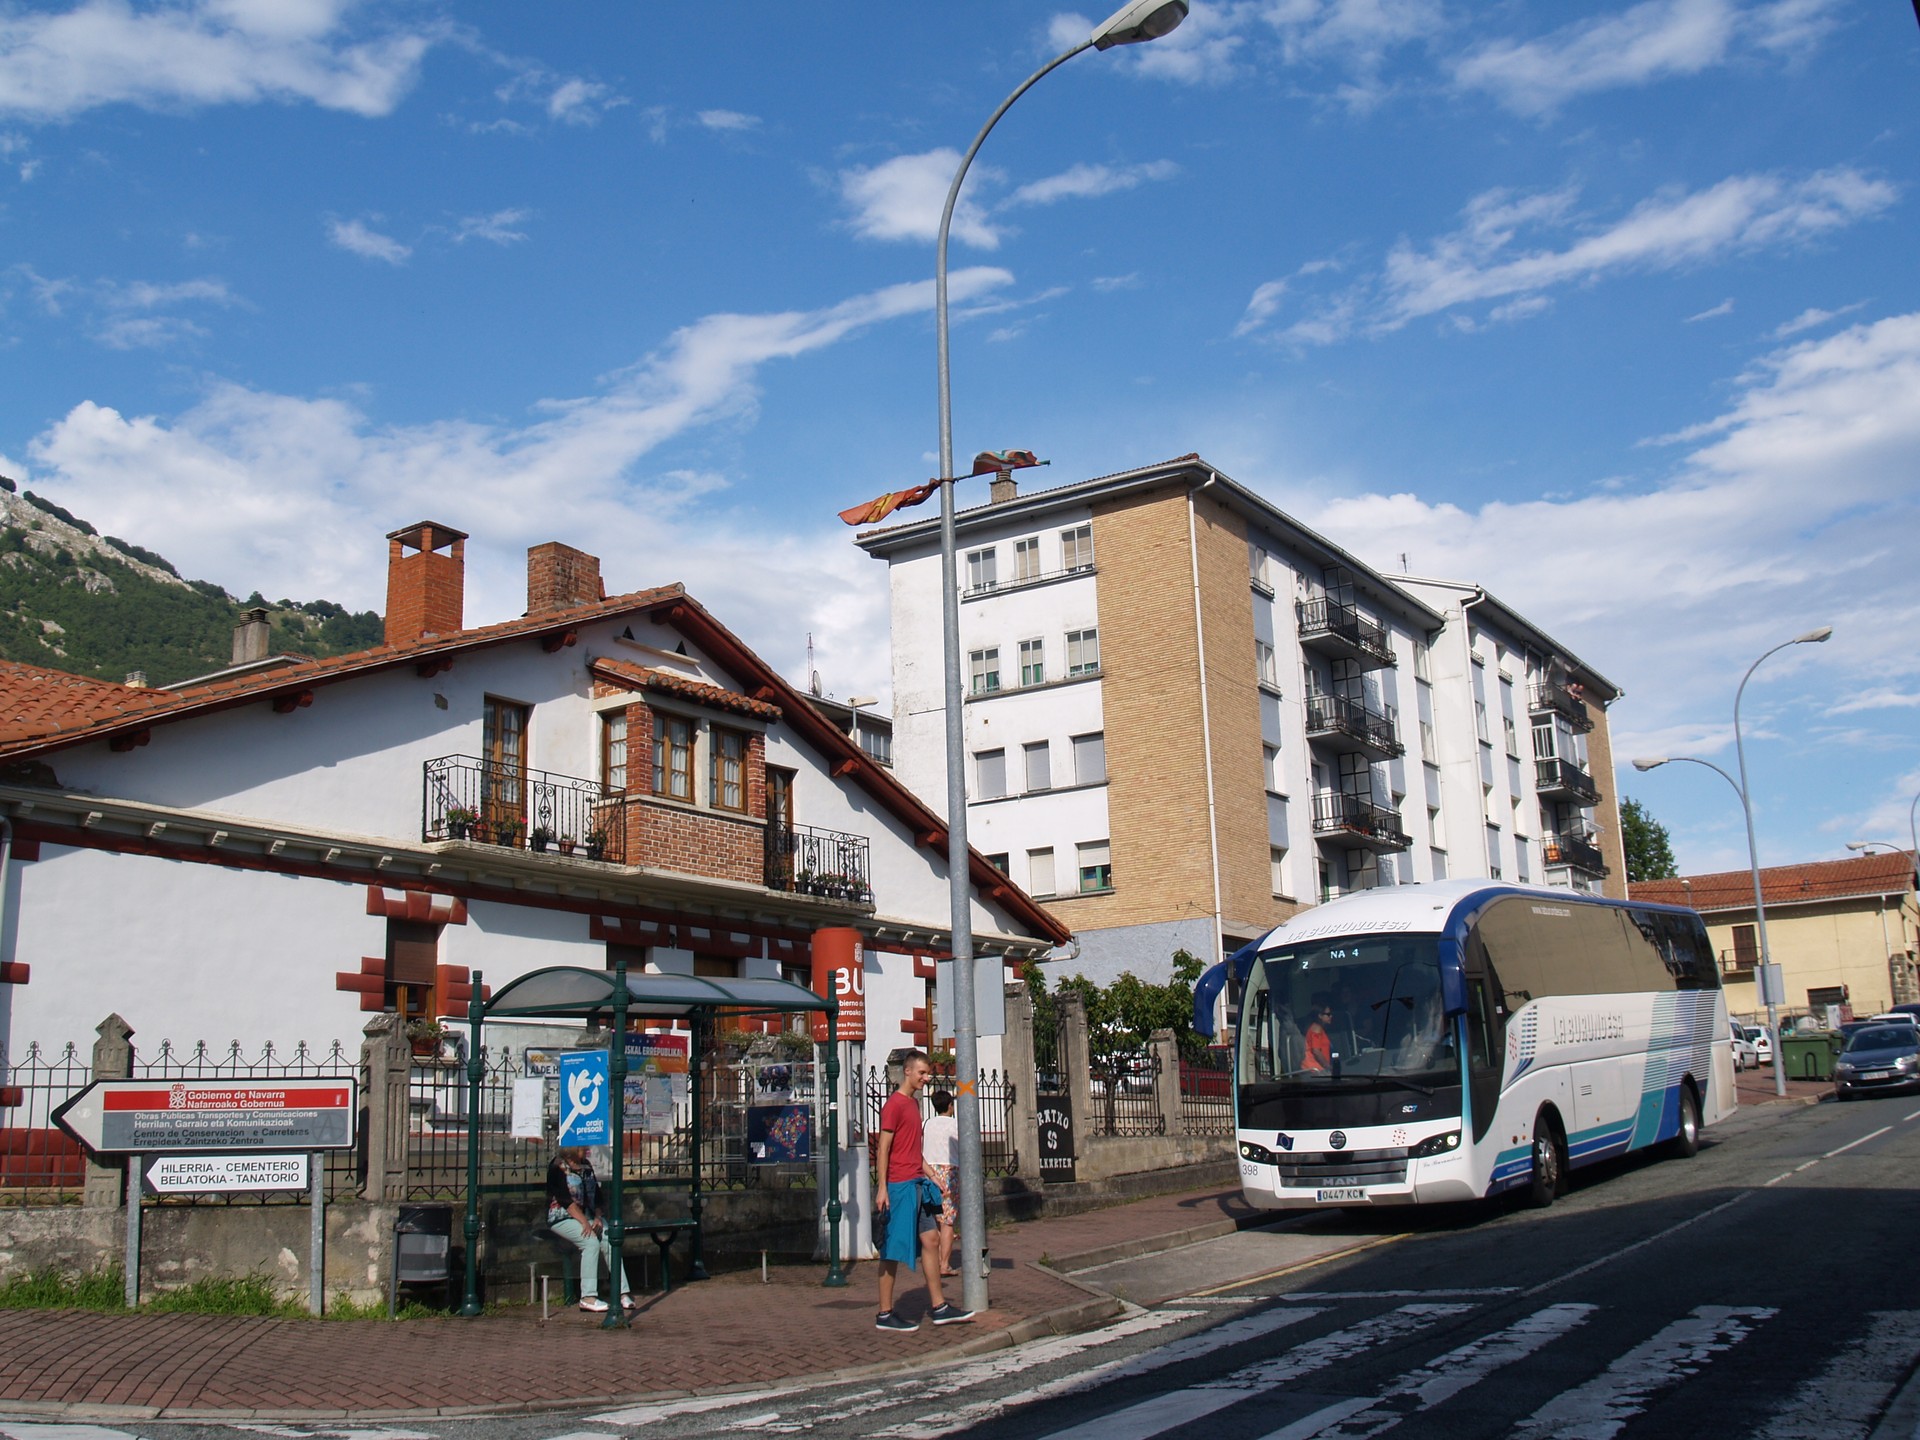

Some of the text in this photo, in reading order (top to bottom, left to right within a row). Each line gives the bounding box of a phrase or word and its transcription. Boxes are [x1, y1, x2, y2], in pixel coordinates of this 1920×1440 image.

[1285, 929, 1307, 944] LA
[1330, 948, 1359, 959] NA 4
[530, 1065, 551, 1075] ALDE
[187, 1090, 286, 1100] Gobierno de Navarra
[186, 1099, 285, 1109] Nafarroako Gobernua
[134, 1110, 318, 1120] Obras Públicas Transportes y Comunicaciones
[134, 1118, 294, 1129] Herrilan, Garraio eta Komunikazioak
[585, 1118, 604, 1127] orain
[133, 1129, 165, 1138] Centro
[167, 1129, 179, 1138] de
[576, 1126, 604, 1135] presoak
[133, 1136, 264, 1147] Errepideak Zaintzeko Zentroa
[161, 1163, 214, 1174] HILERRIA
[225, 1161, 300, 1172] CEMENTERIO
[1241, 1165, 1259, 1176] 398
[160, 1174, 227, 1185] BEILATOKIA
[236, 1173, 300, 1184] TANATORIO
[1322, 1176, 1358, 1187] MAN
[1322, 1189, 1345, 1200] 0447
